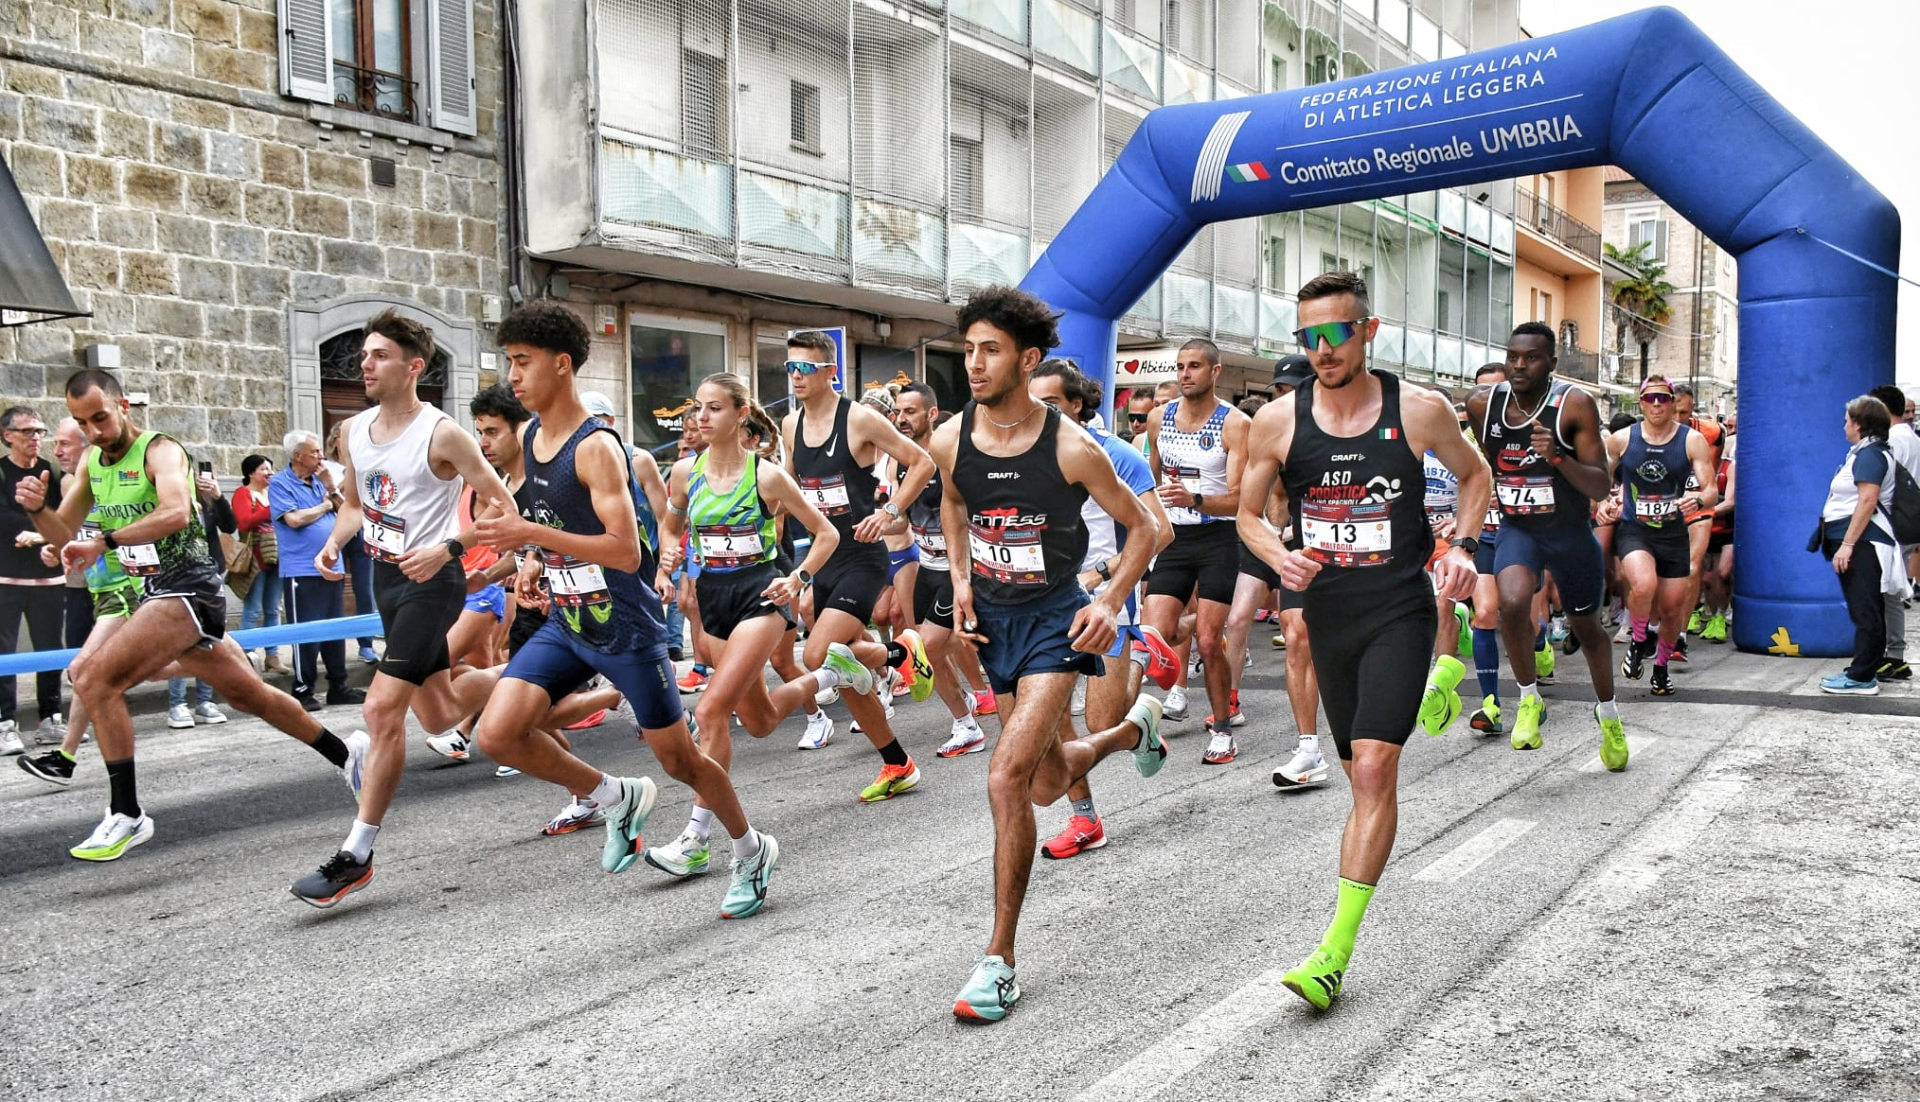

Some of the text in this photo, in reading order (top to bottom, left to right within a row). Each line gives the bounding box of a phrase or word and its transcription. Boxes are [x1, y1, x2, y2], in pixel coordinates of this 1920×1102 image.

[1300, 46, 1558, 108] FEDERAZIONE ITALIANA
[1304, 70, 1545, 129] DI ATLETICA LEGGERA
[1281, 114, 1583, 185] Comitato Regionale UMBRIA
[1115, 361, 1124, 374] I
[1505, 443, 1521, 451] ASD
[1321, 470, 1352, 486] ASD
[816, 490, 825, 503] 8
[1309, 485, 1367, 499] PODISTICA
[1510, 488, 1536, 505] 74
[1644, 502, 1671, 515] 187
[370, 524, 384, 542] 12
[922, 535, 934, 546] 16
[1330, 523, 1357, 544] 13
[724, 537, 734, 551] 2
[1319, 541, 1353, 551] MALFAGIA
[122, 546, 136, 560] 14
[988, 545, 1012, 564] 10
[559, 570, 577, 587] 11
